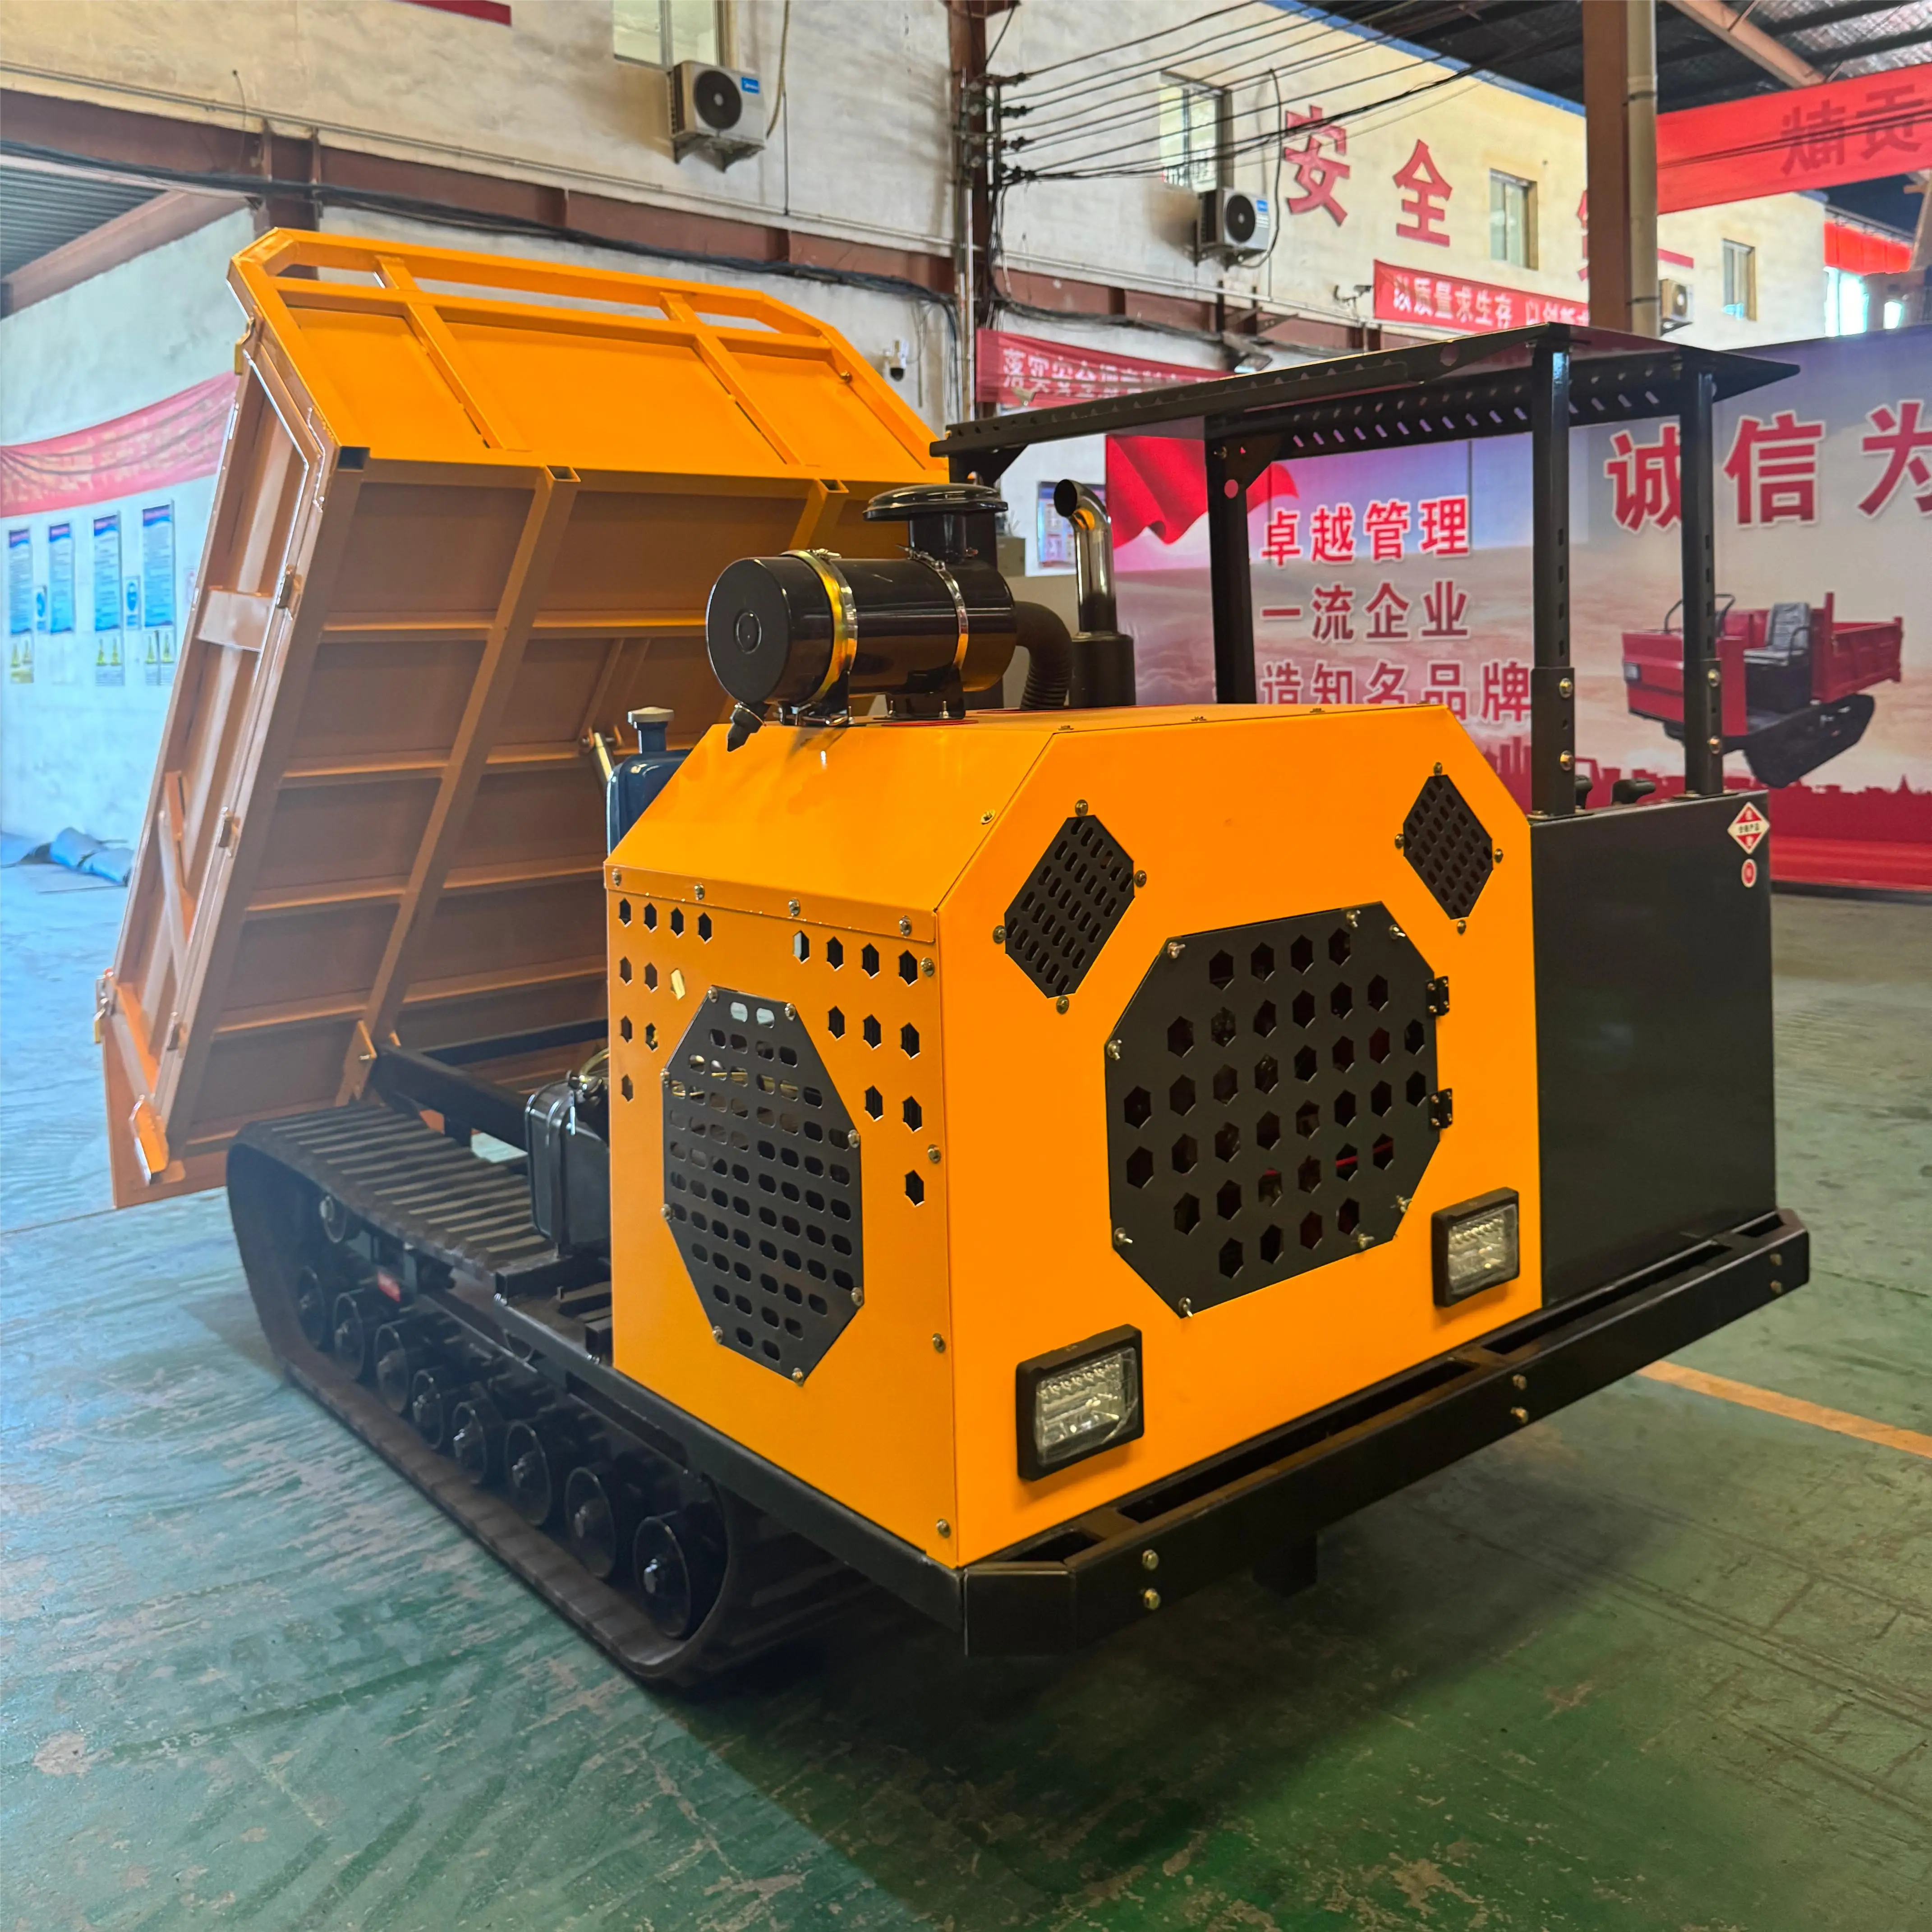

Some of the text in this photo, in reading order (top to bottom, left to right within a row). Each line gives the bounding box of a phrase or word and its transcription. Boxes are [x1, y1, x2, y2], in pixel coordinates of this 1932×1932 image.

[1394, 274, 1513, 328] 以质量求生存
[1606, 401, 1932, 532] 诚信为
[1260, 497, 1469, 566] 卓越管理
[1261, 580, 1468, 641] 一流企业
[1261, 661, 1532, 722] 造知名品牌
